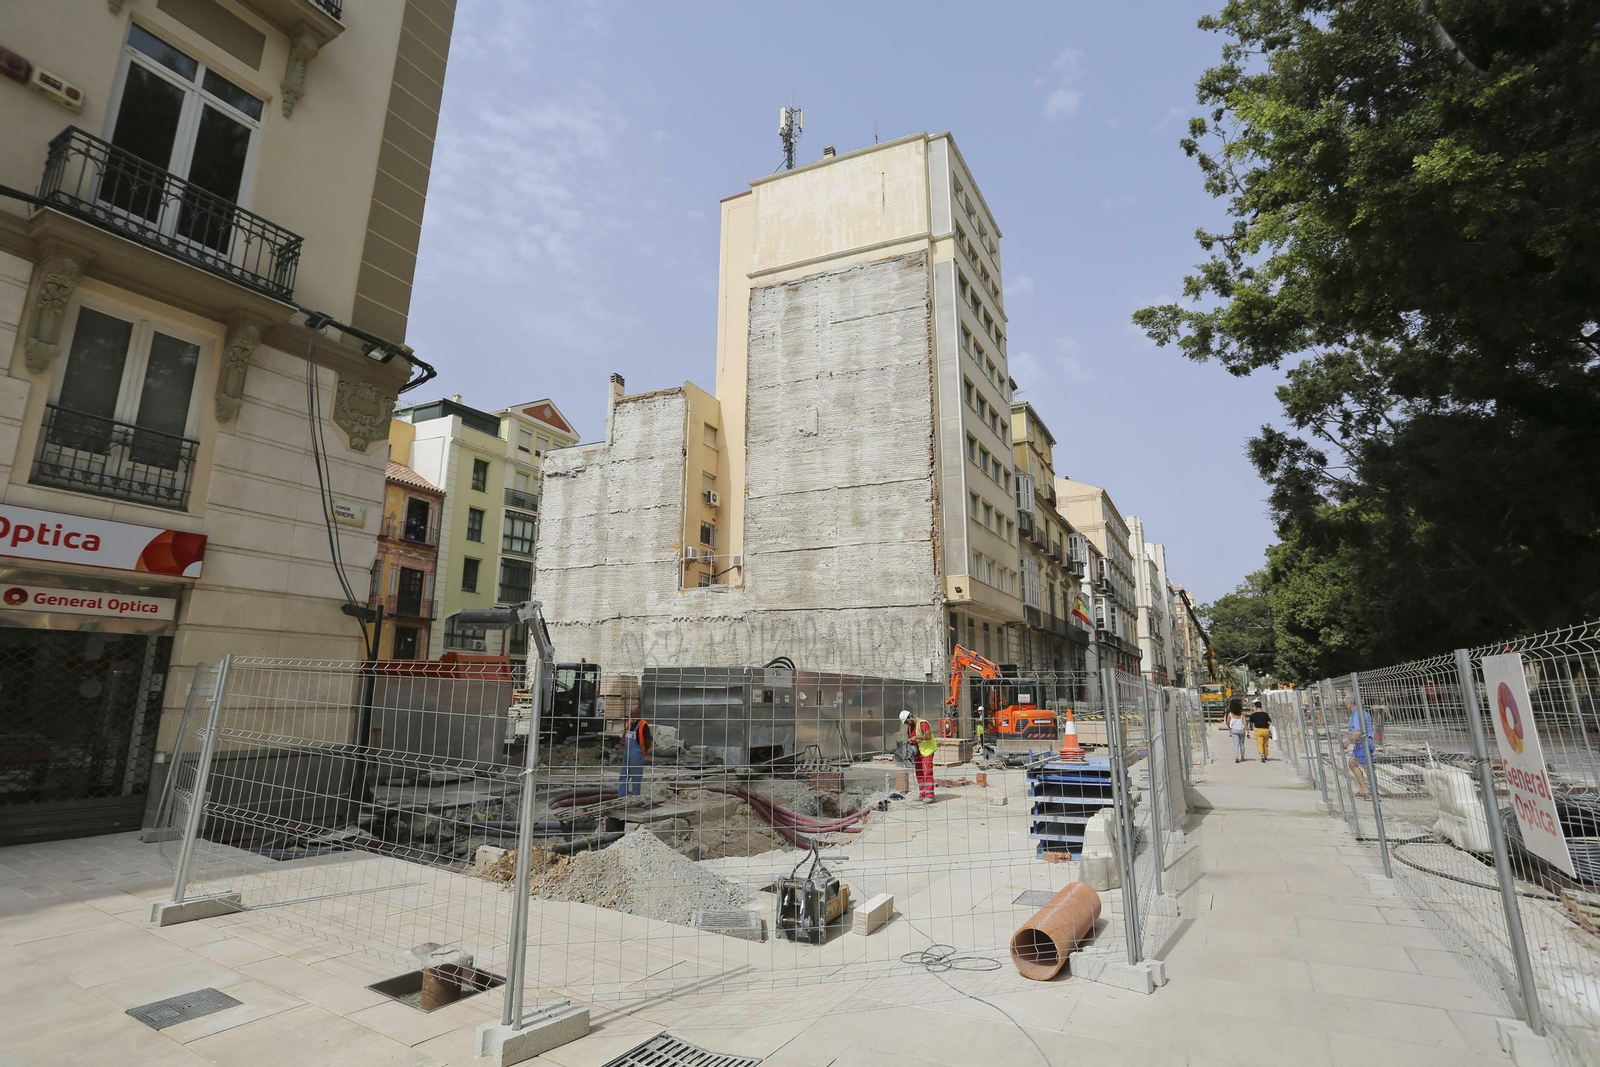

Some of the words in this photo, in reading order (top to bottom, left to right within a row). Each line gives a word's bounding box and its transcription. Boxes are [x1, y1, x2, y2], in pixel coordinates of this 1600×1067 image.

[335, 510, 355, 519] PRINCIPAL
[33, 592, 103, 609] General
[107, 599, 159, 613] Optica
[1503, 760, 1552, 800] General
[1514, 793, 1557, 837] Optica
